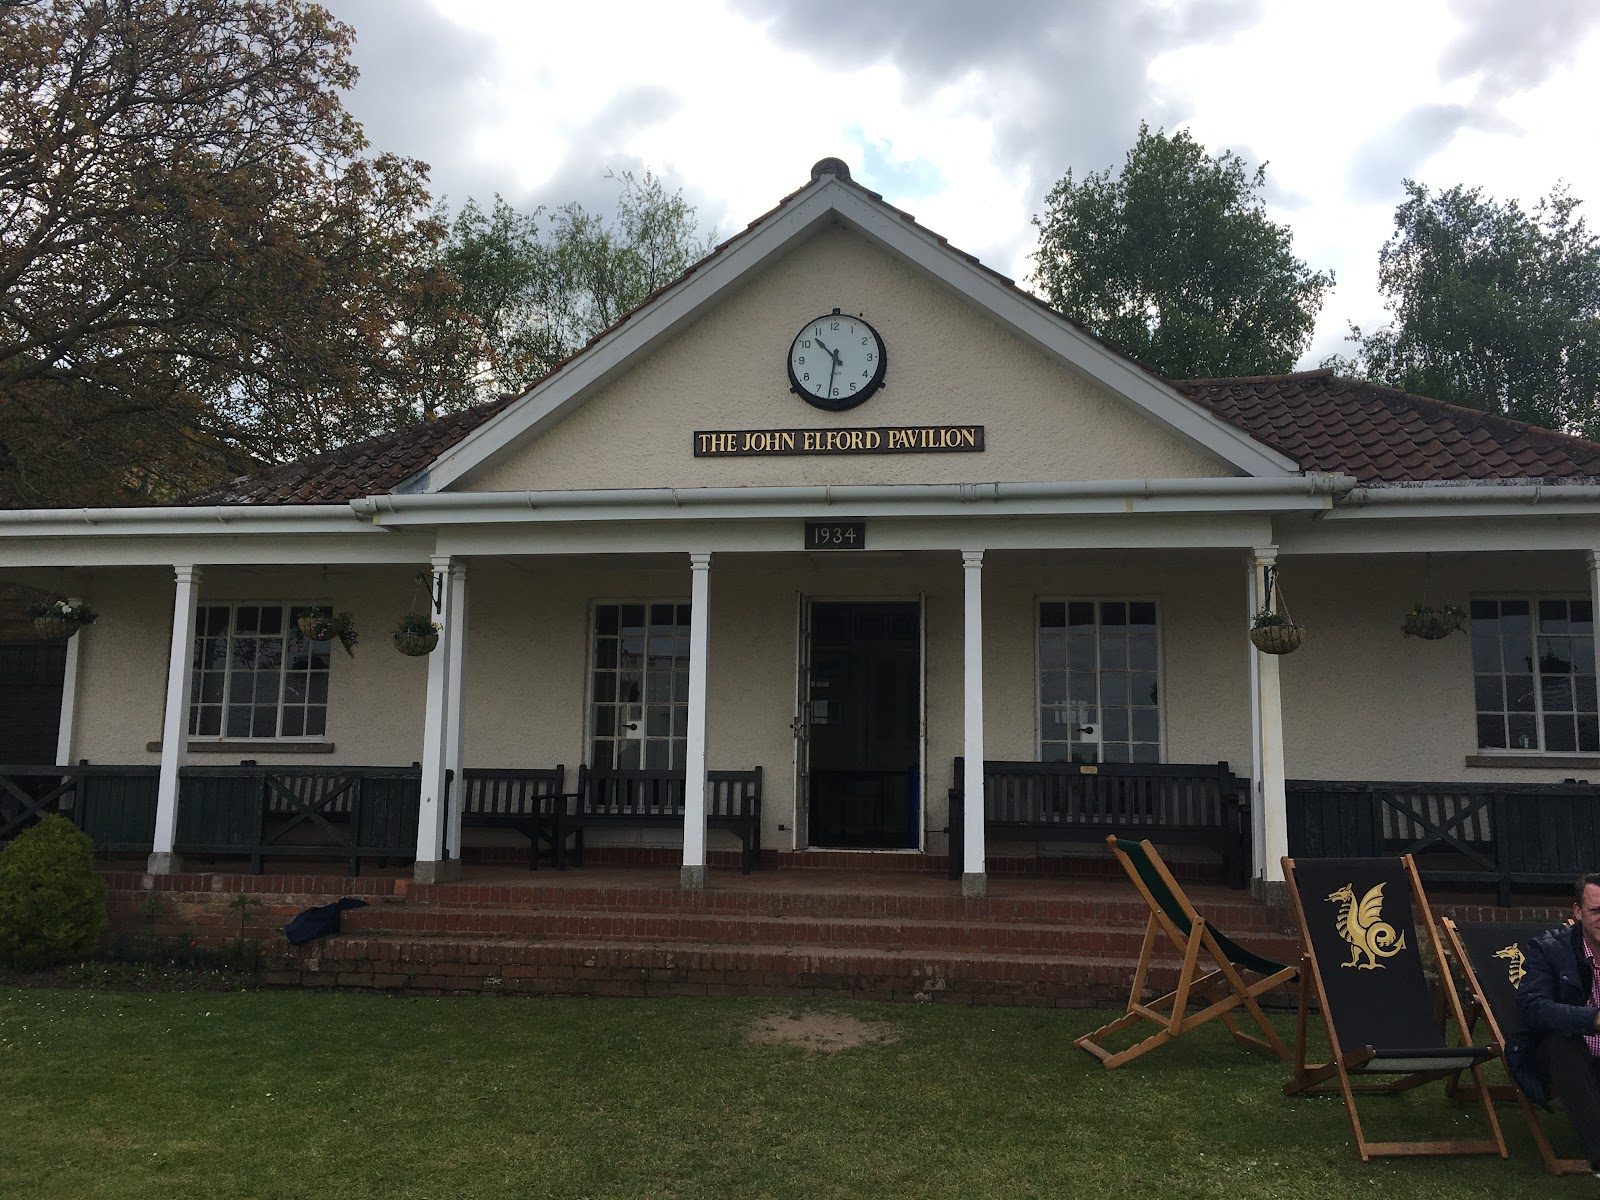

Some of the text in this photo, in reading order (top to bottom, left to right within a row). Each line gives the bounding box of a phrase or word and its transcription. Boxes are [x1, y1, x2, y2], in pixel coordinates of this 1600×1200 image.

[830, 323, 840, 331] 12
[815, 328, 822, 336] 11
[801, 340, 811, 349] 10
[861, 337, 868, 346] 2
[798, 357, 805, 365] 9
[866, 354, 873, 362] 3
[803, 373, 810, 381] 8
[862, 370, 868, 378] 4
[816, 384, 822, 393] 7
[850, 383, 856, 391] 5
[832, 388, 839, 396] 6
[698, 429, 976, 452] THE JOHN ELFORD PAVILION
[815, 528, 856, 544] 1934
